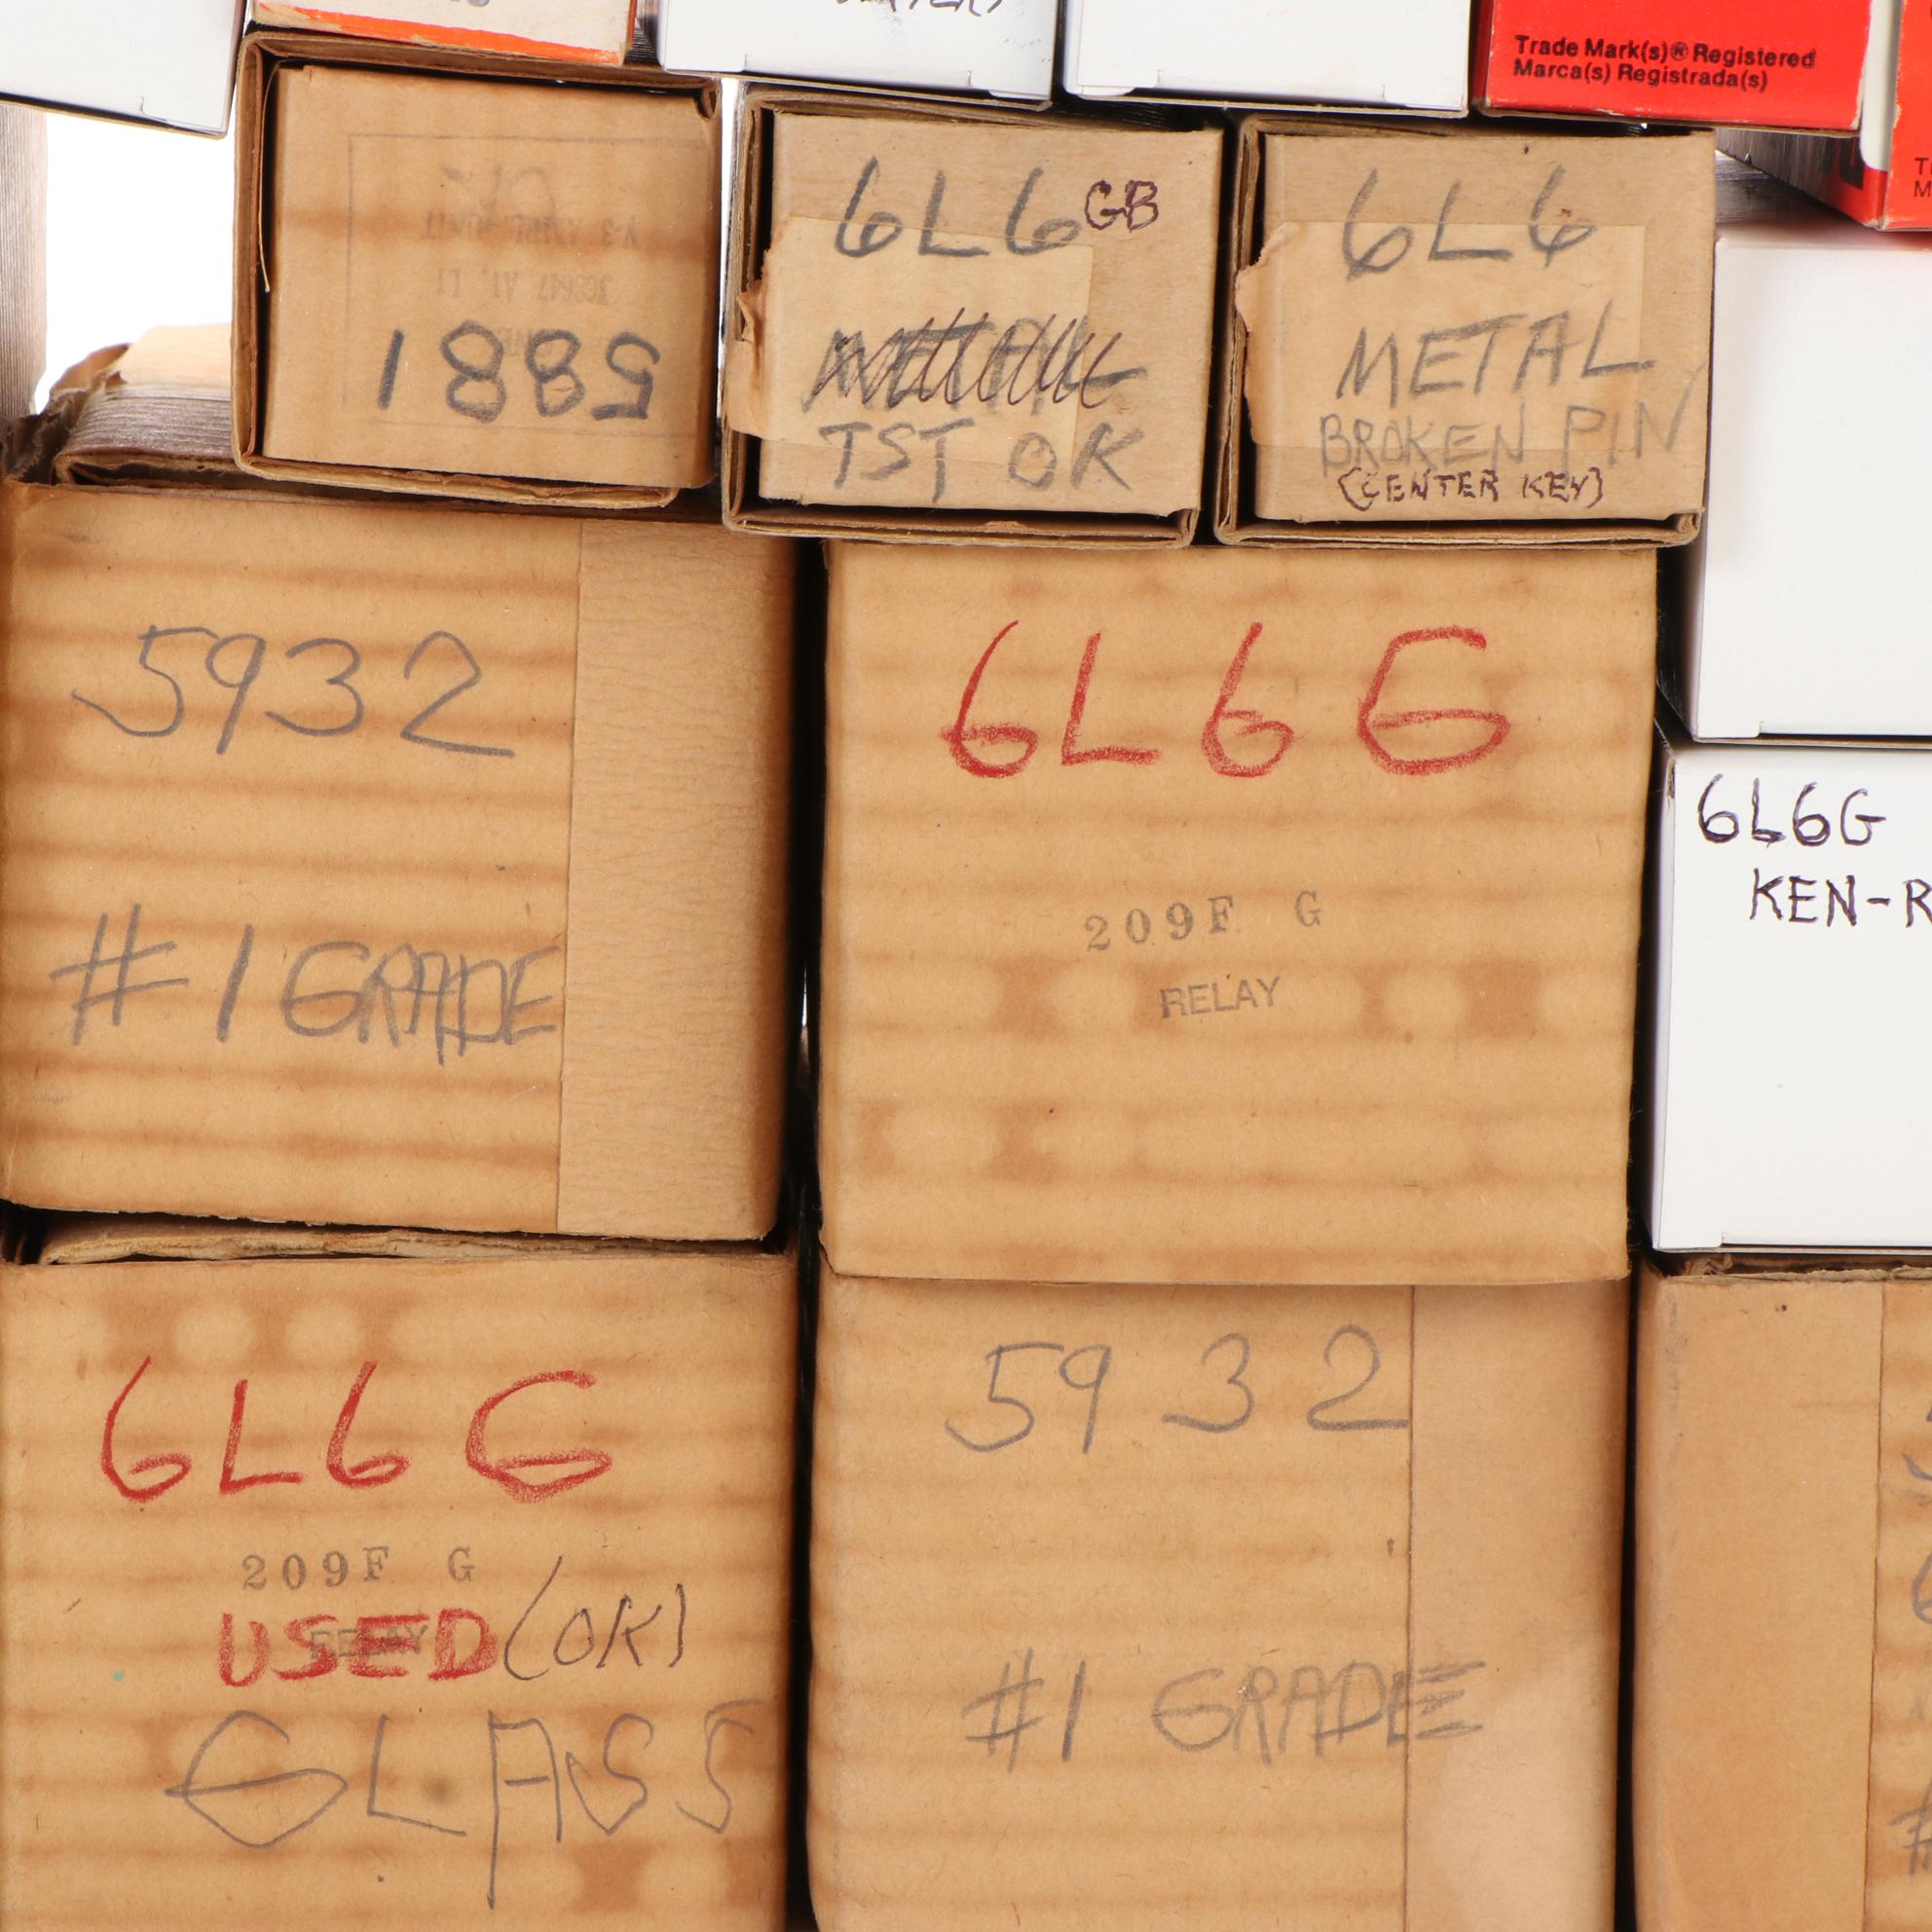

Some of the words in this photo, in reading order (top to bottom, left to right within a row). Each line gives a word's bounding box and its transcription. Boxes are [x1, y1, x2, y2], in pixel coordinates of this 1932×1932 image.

[1513, 57, 1612, 85] Marca(s)
[1616, 62, 1768, 93] Registrada(s)
[1514, 35, 1579, 56] Trade
[1692, 43, 1816, 69] Registered
[1341, 166, 1598, 280] 6L6
[378, 318, 660, 425] 5881
[1335, 300, 1657, 408] METAL
[818, 417, 977, 503] TST
[1008, 422, 1146, 492] OK
[1319, 401, 1527, 477] BROKEN
[1564, 366, 1706, 471] PIN
[72, 623, 514, 759] 5932
[1697, 773, 1887, 848] 6L6G
[1083, 894, 1235, 951] 209F
[1294, 889, 1322, 929] G
[1749, 867, 1932, 929] KEN-R
[280, 939, 558, 1066] GRADE
[1160, 975, 1282, 1020] RELAY
[944, 1323, 1409, 1454] 5932
[241, 1544, 391, 1591] 209F
[448, 1545, 475, 1583] G
[217, 1607, 499, 1688] USED
[960, 1647, 1088, 1773] #1
[1151, 1659, 1487, 1765] GRADE
[164, 1698, 764, 1910] GLASS
